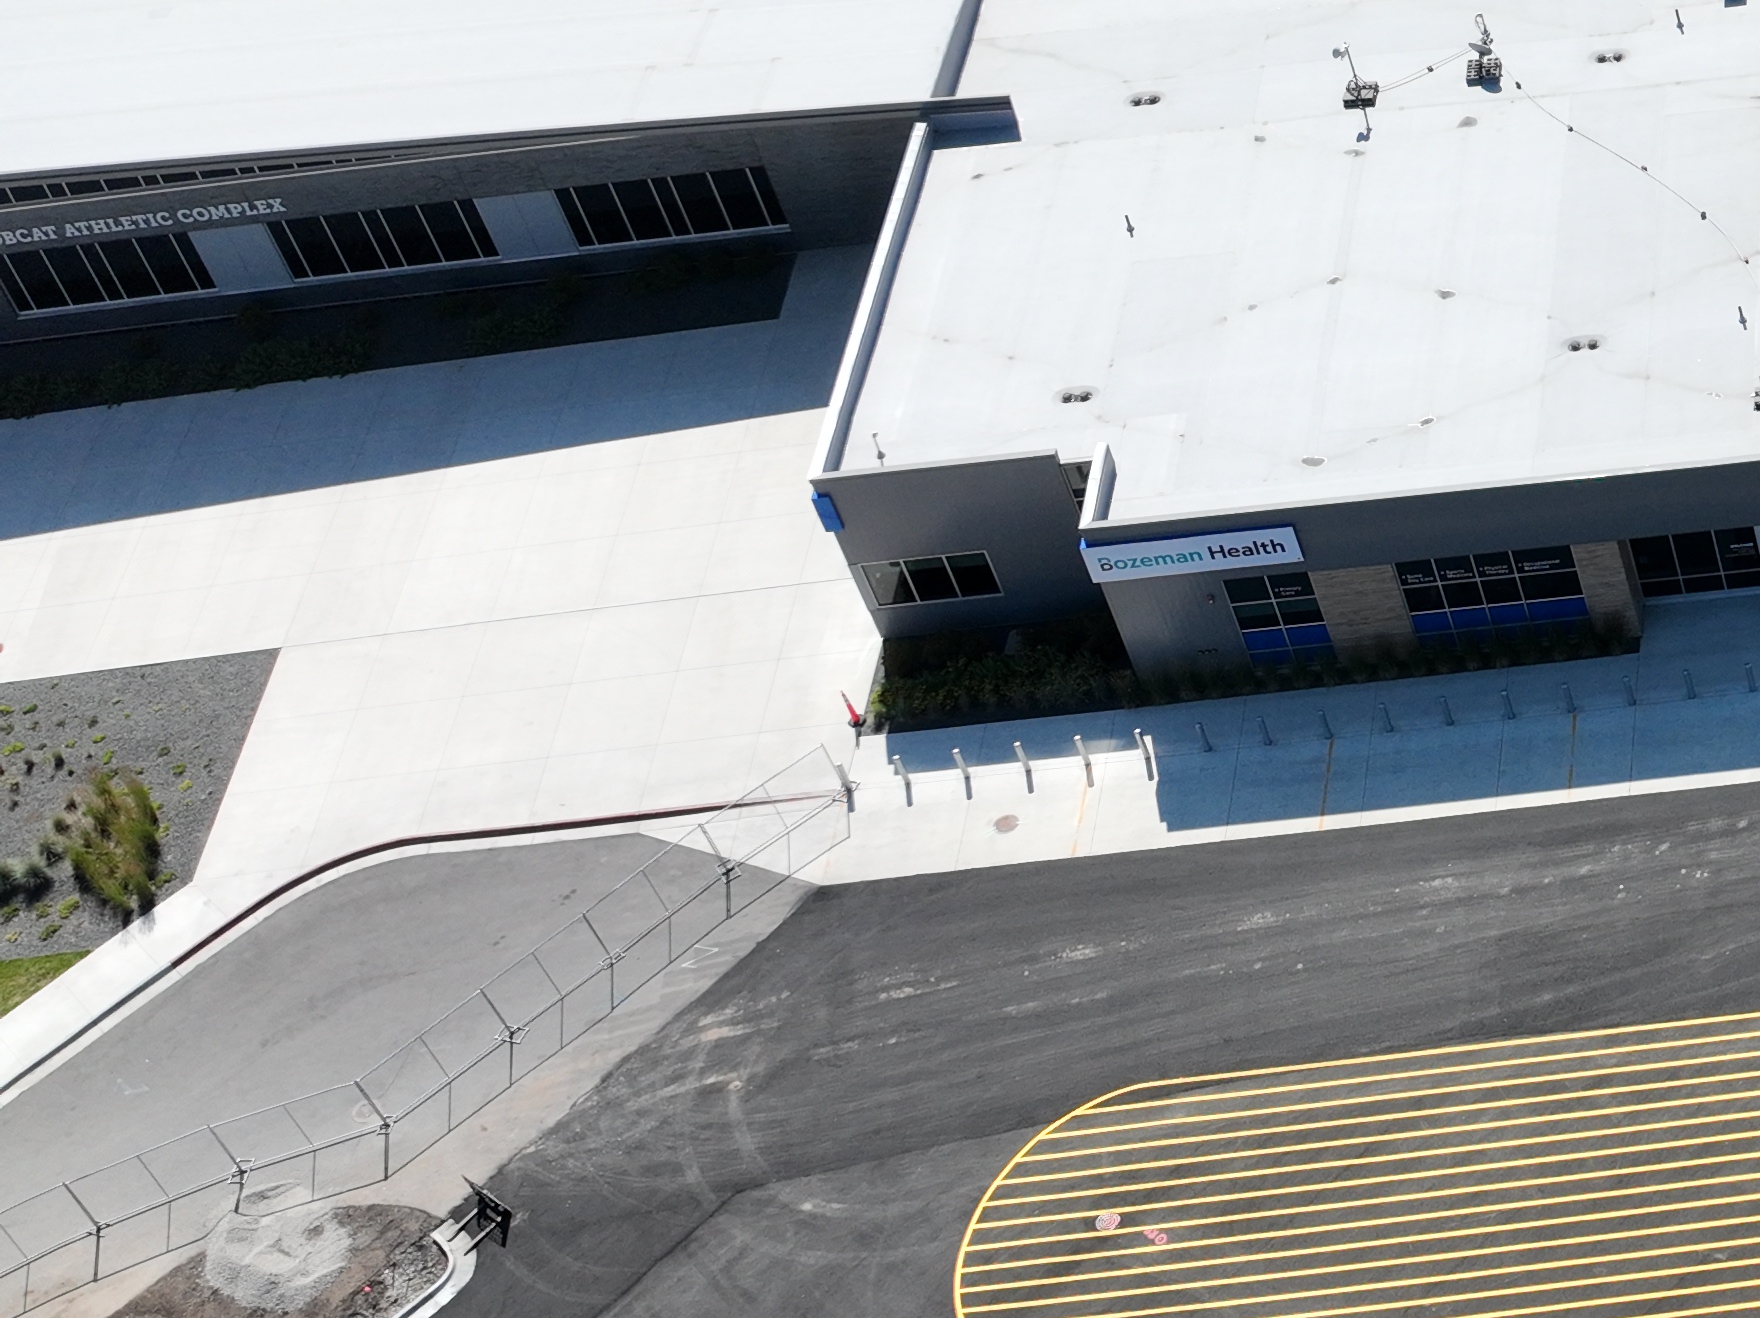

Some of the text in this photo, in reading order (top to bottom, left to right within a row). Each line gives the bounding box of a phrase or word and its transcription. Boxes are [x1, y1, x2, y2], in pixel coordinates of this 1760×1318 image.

[0, 198, 287, 246] BCAT ATHLETIC COMPLEX
[1097, 538, 1286, 572] Bozeman Health
